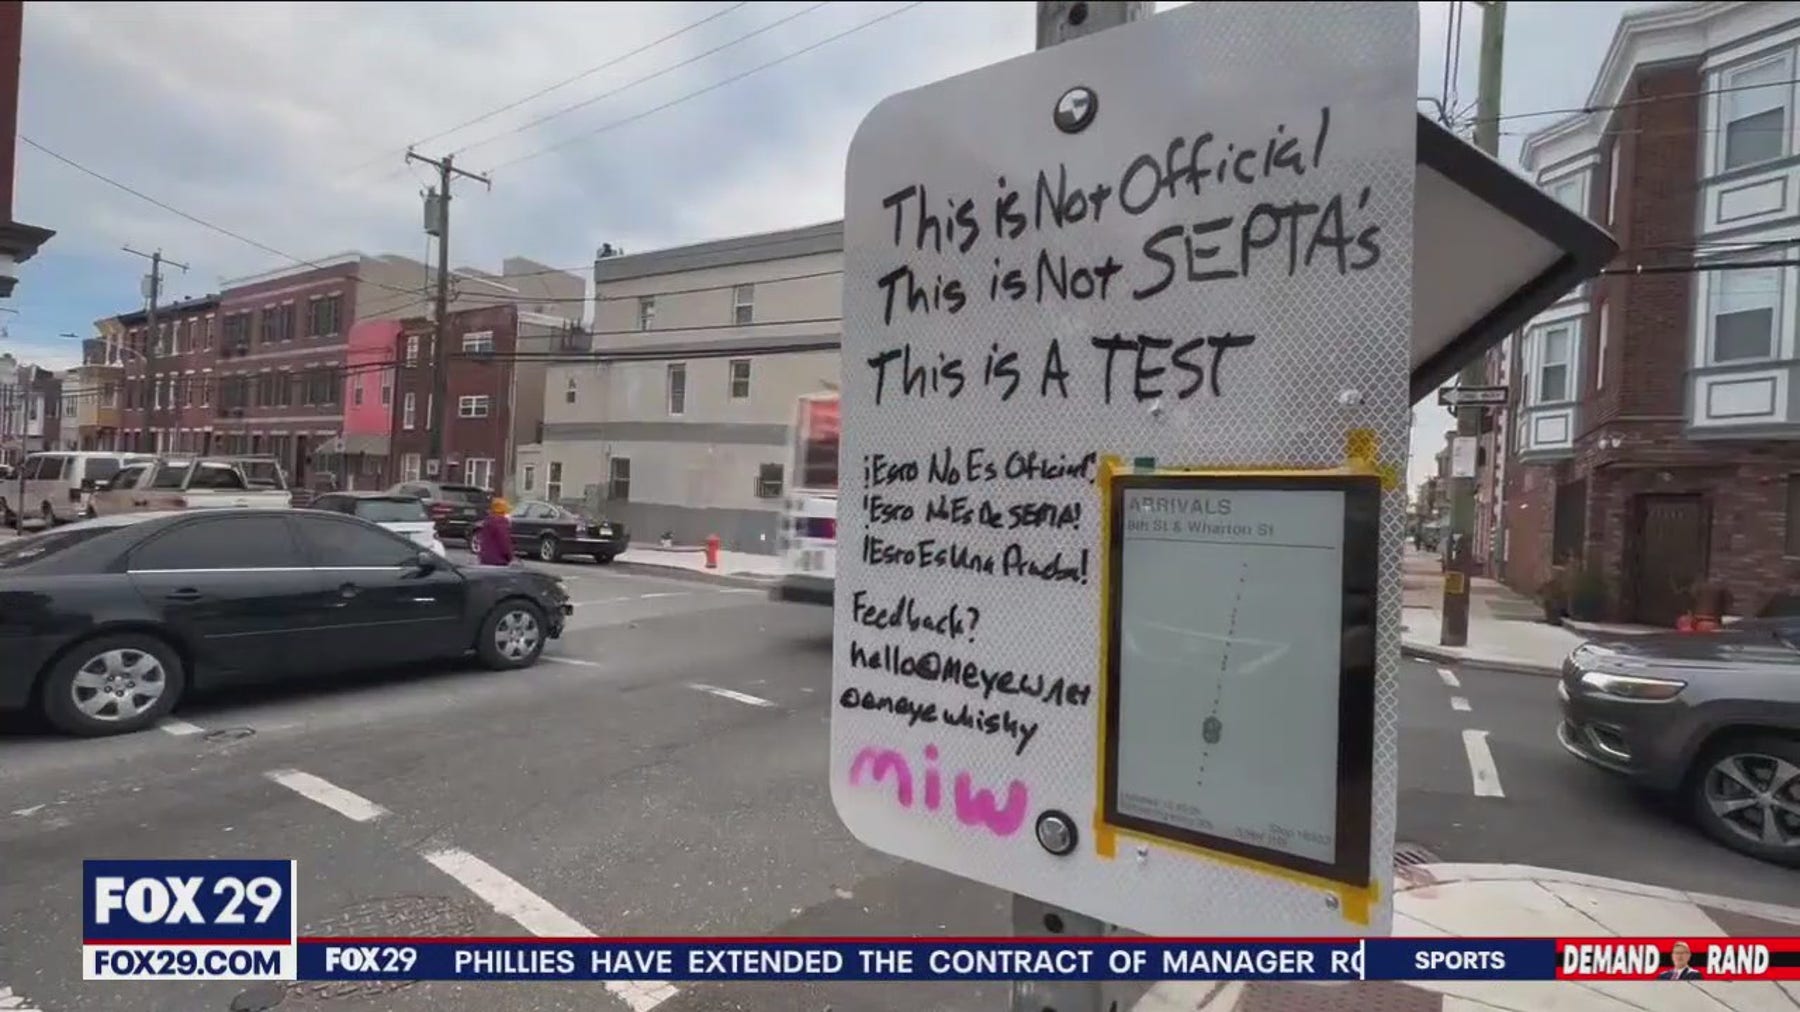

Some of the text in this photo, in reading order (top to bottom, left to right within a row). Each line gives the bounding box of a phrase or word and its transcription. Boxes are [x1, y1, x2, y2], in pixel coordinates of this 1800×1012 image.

[883, 107, 1331, 253] This is Not Official
[877, 186, 1382, 325] This is Not SEPTA's
[868, 332, 1255, 404] This is A TEST
[928, 446, 960, 485] No
[967, 448, 997, 482] Es
[926, 494, 950, 523] No
[951, 497, 975, 525] Es
[979, 499, 1004, 528] De
[1128, 496, 1233, 516] ARRIVALS
[1152, 519, 1169, 532] St
[1173, 520, 1183, 533] &
[1187, 520, 1253, 537] Wharton
[1257, 523, 1275, 537] St
[917, 538, 947, 568] Es
[951, 544, 996, 575] Una
[853, 590, 980, 643] Feedback?
[850, 743, 1028, 837] miw
